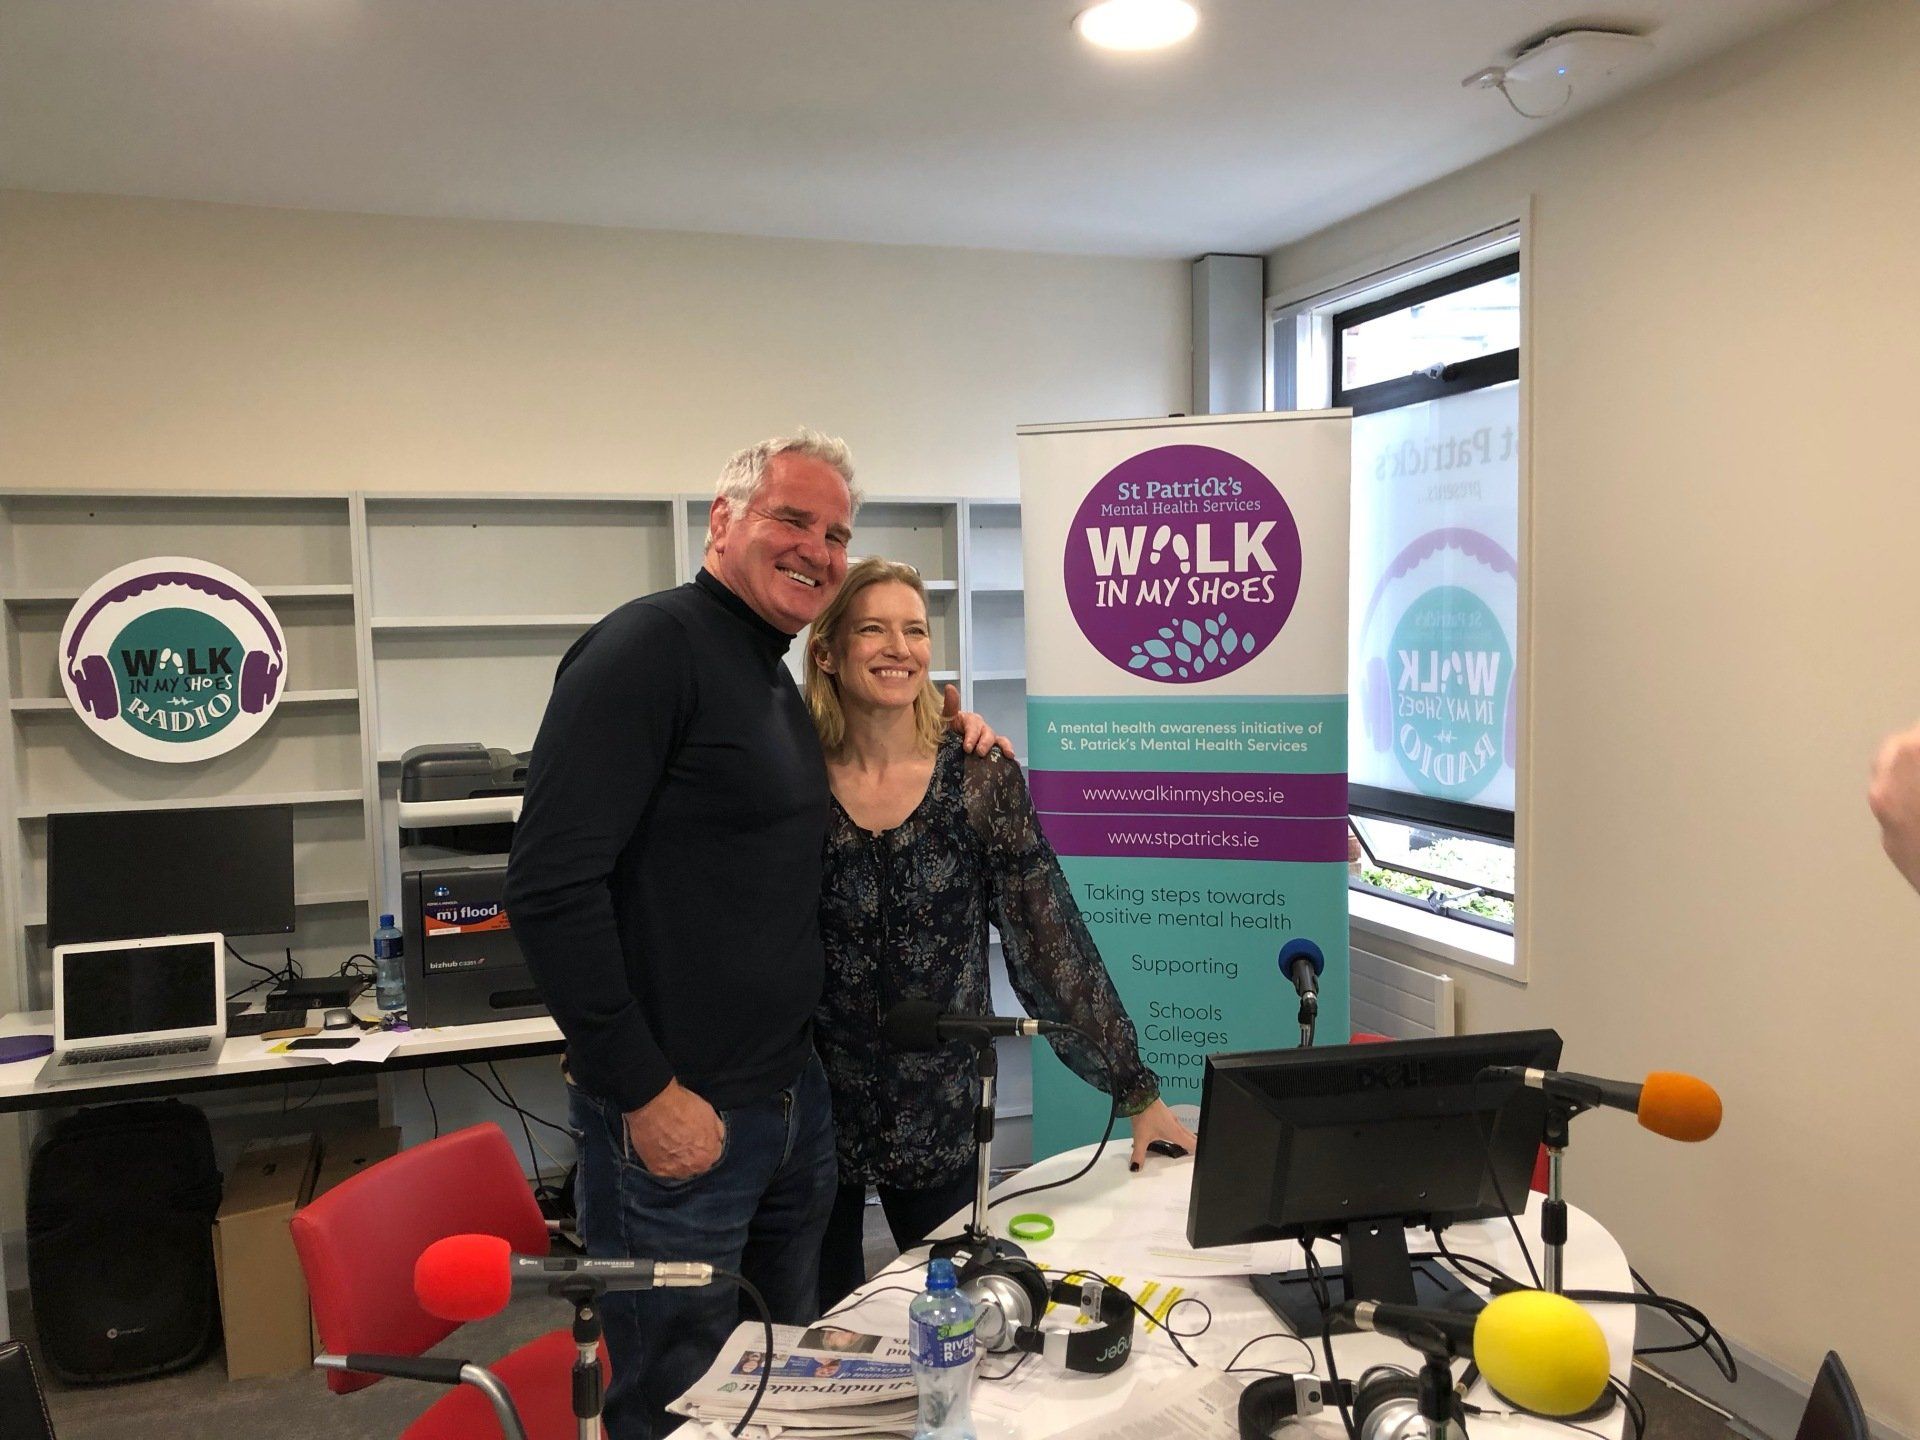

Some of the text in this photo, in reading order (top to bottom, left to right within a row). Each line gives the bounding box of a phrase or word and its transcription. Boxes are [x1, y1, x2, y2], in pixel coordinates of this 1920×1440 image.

[1118, 477, 1242, 500] St Patrick's
[1100, 499, 1261, 517] Mental Health Services
[1096, 574, 1275, 607] IN MY SHOES
[129, 674, 232, 694] IN MY SHOES
[126, 693, 232, 732] RADIO
[1047, 721, 1323, 735] A mental health awareness initiative of
[1060, 738, 1308, 752] St. Patrick's Mental Health Services
[1082, 785, 1285, 806] www.walkinmyshoes.ie
[1107, 830, 1260, 848] www.stpatricks.ie
[1083, 883, 1287, 907] Taking steps towards
[436, 909, 457, 922] mj
[460, 904, 498, 919] flood
[1157, 911, 1223, 928] mental
[1230, 912, 1292, 930] health
[429, 961, 458, 969] bizhub
[1132, 955, 1239, 979] Supporting
[1149, 1001, 1223, 1021] Schools
[1144, 1024, 1228, 1047] Colleges
[943, 1334, 975, 1352] RIVER
